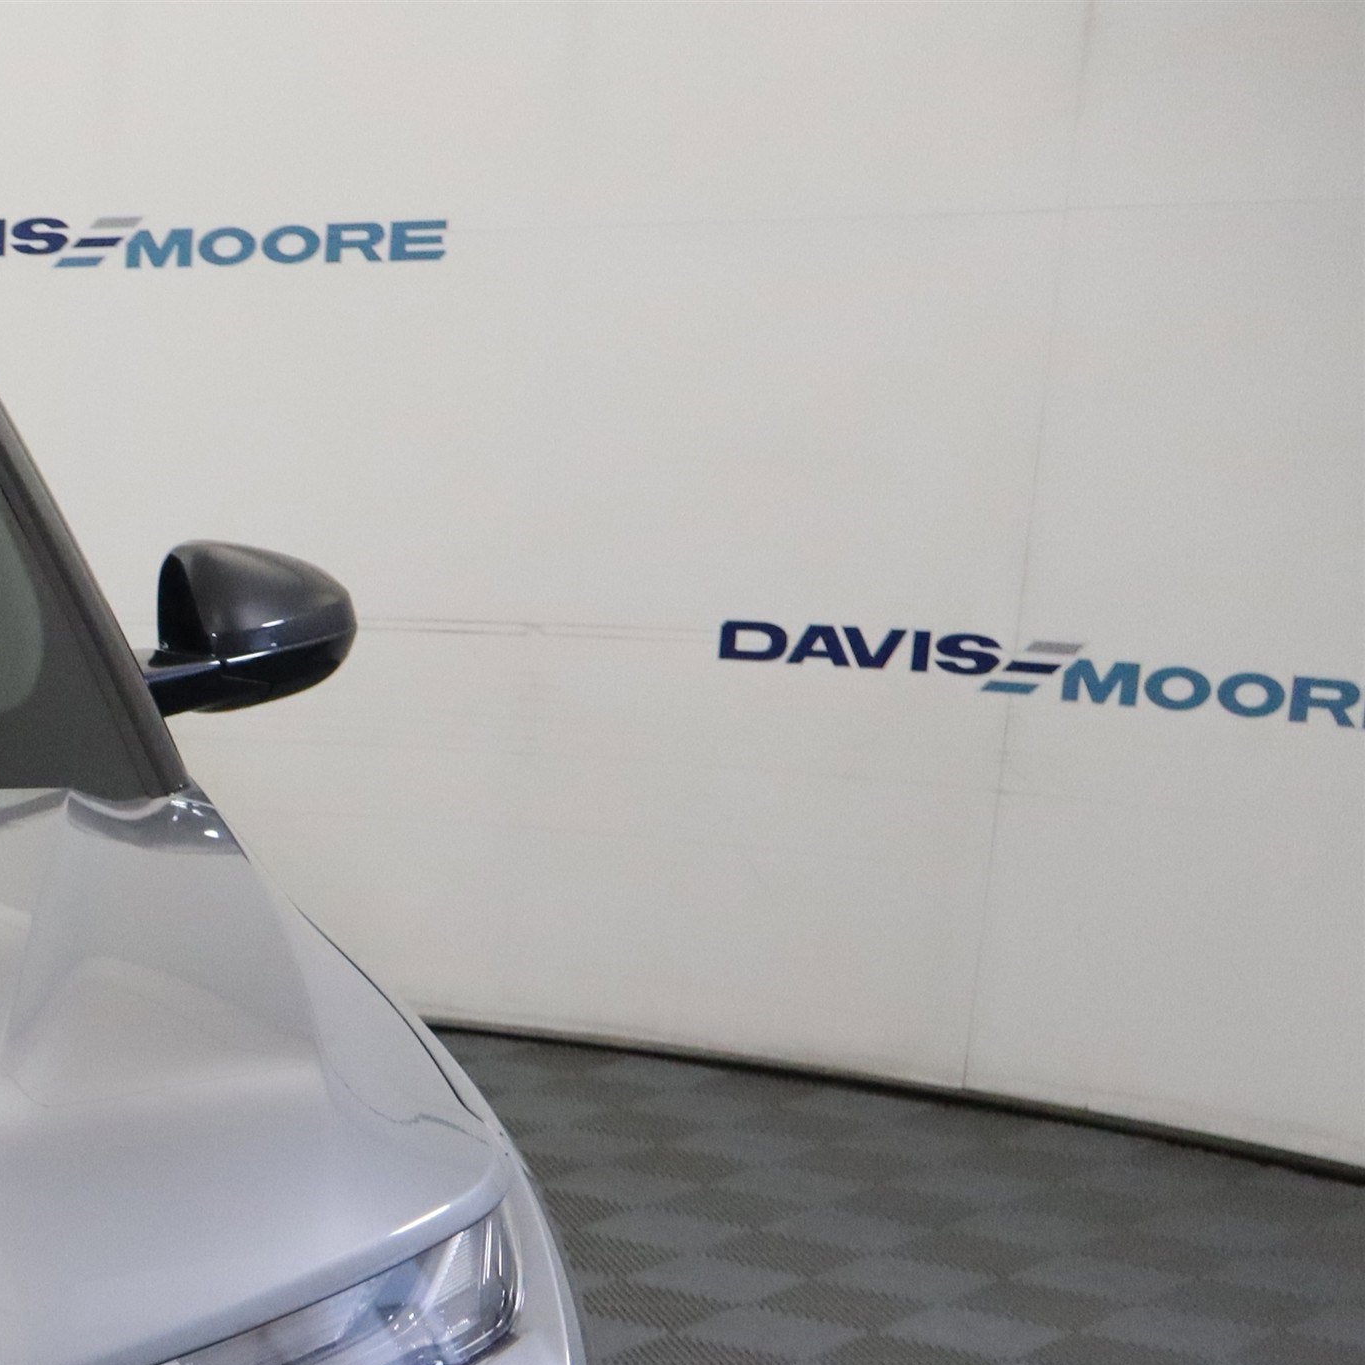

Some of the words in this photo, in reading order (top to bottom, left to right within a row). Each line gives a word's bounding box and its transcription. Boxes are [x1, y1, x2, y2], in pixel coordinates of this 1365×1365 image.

[125, 219, 448, 269] MOORE
[717, 619, 1002, 676] DAVIS
[1060, 658, 1365, 731] MOOR
